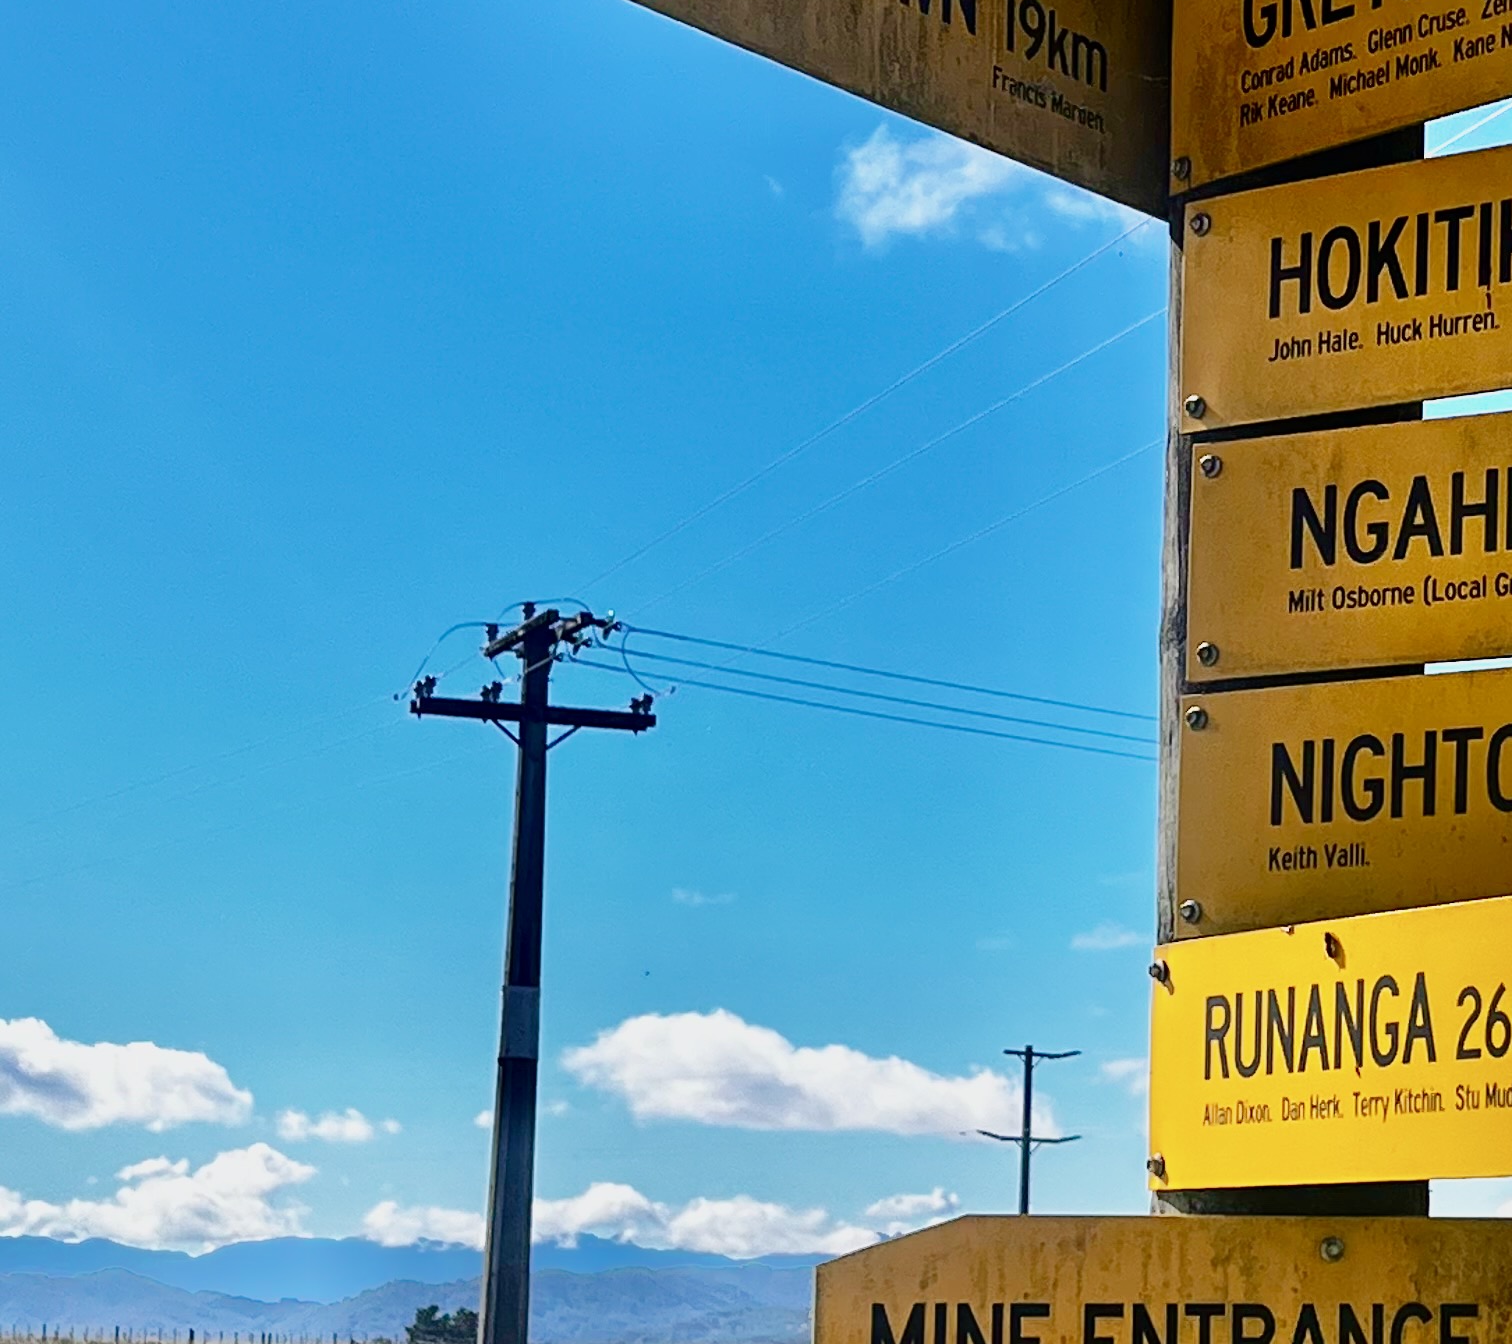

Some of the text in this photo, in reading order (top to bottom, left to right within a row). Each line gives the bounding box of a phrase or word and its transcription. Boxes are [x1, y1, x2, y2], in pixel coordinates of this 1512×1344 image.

[1241, 56, 1294, 94] Conrad
[1367, 24, 1413, 54] Glenn
[1417, 7, 1470, 39] Cruse.
[992, 65, 1047, 109] Francis
[1240, 103, 1264, 128] Rik
[1268, 88, 1319, 119] Keane.
[1330, 61, 1390, 99] Michael
[1396, 47, 1442, 81] Monk.
[1454, 33, 1496, 63] Kane
[1268, 311, 1501, 362] John Hale. Huck Hurren.
[1288, 588, 1325, 614] Milt
[1332, 585, 1416, 610] Osborne
[1423, 574, 1487, 606] (Local
[1268, 842, 1371, 872] Keith Valli.
[1204, 972, 1437, 1081] RUNANGA
[1203, 1104, 1233, 1127] Allan
[1281, 1096, 1305, 1122] Dan
[1353, 1091, 1390, 1123] Terry
[1455, 1084, 1481, 1111] Stu
